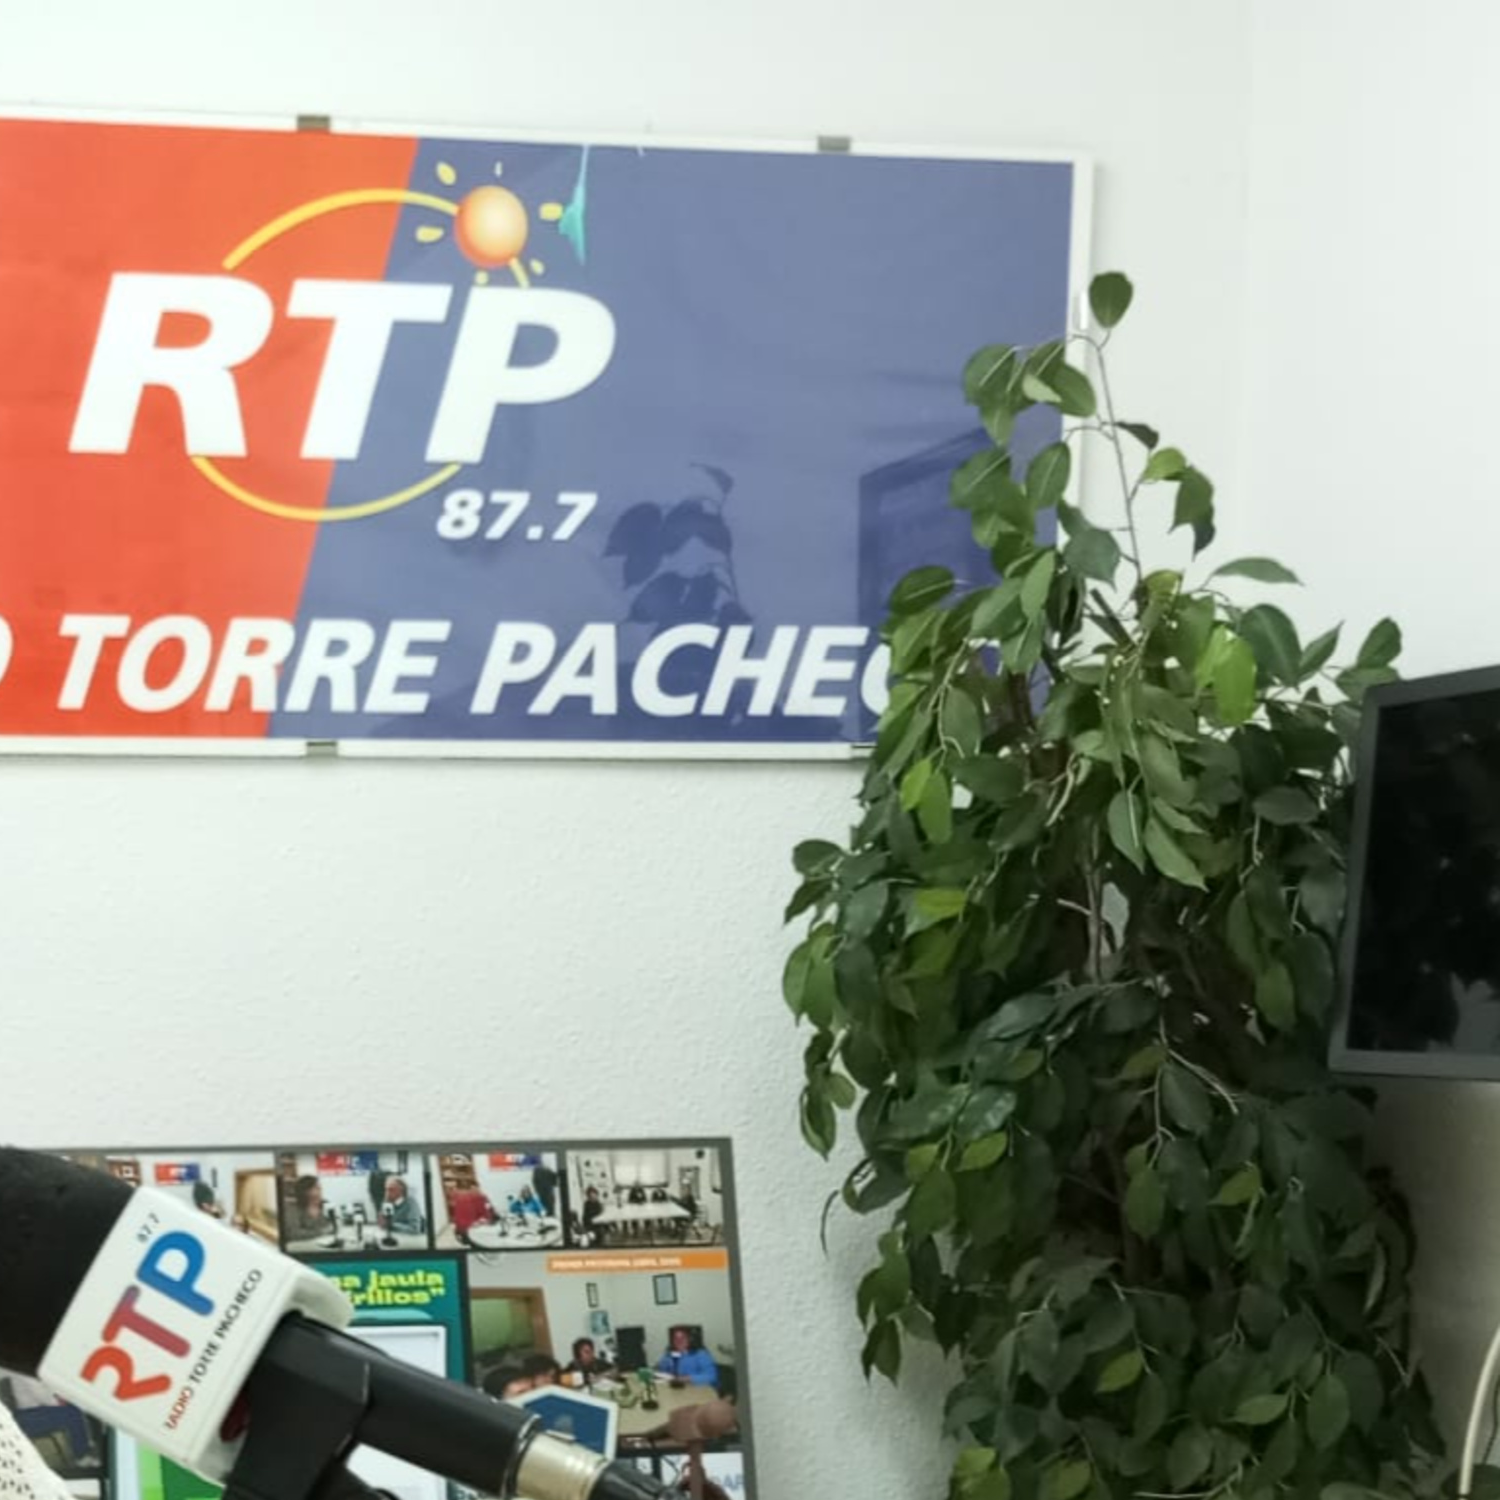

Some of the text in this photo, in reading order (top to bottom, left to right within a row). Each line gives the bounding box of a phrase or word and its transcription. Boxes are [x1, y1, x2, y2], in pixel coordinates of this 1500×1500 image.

[68, 271, 616, 464] RTP
[436, 489, 598, 541] 87.7
[57, 613, 452, 714] TORRE
[468, 620, 893, 718] PACHE
[80, 1230, 216, 1403] RTP
[189, 1341, 221, 1384] TORRE
[214, 1268, 263, 1340] PACHECO
